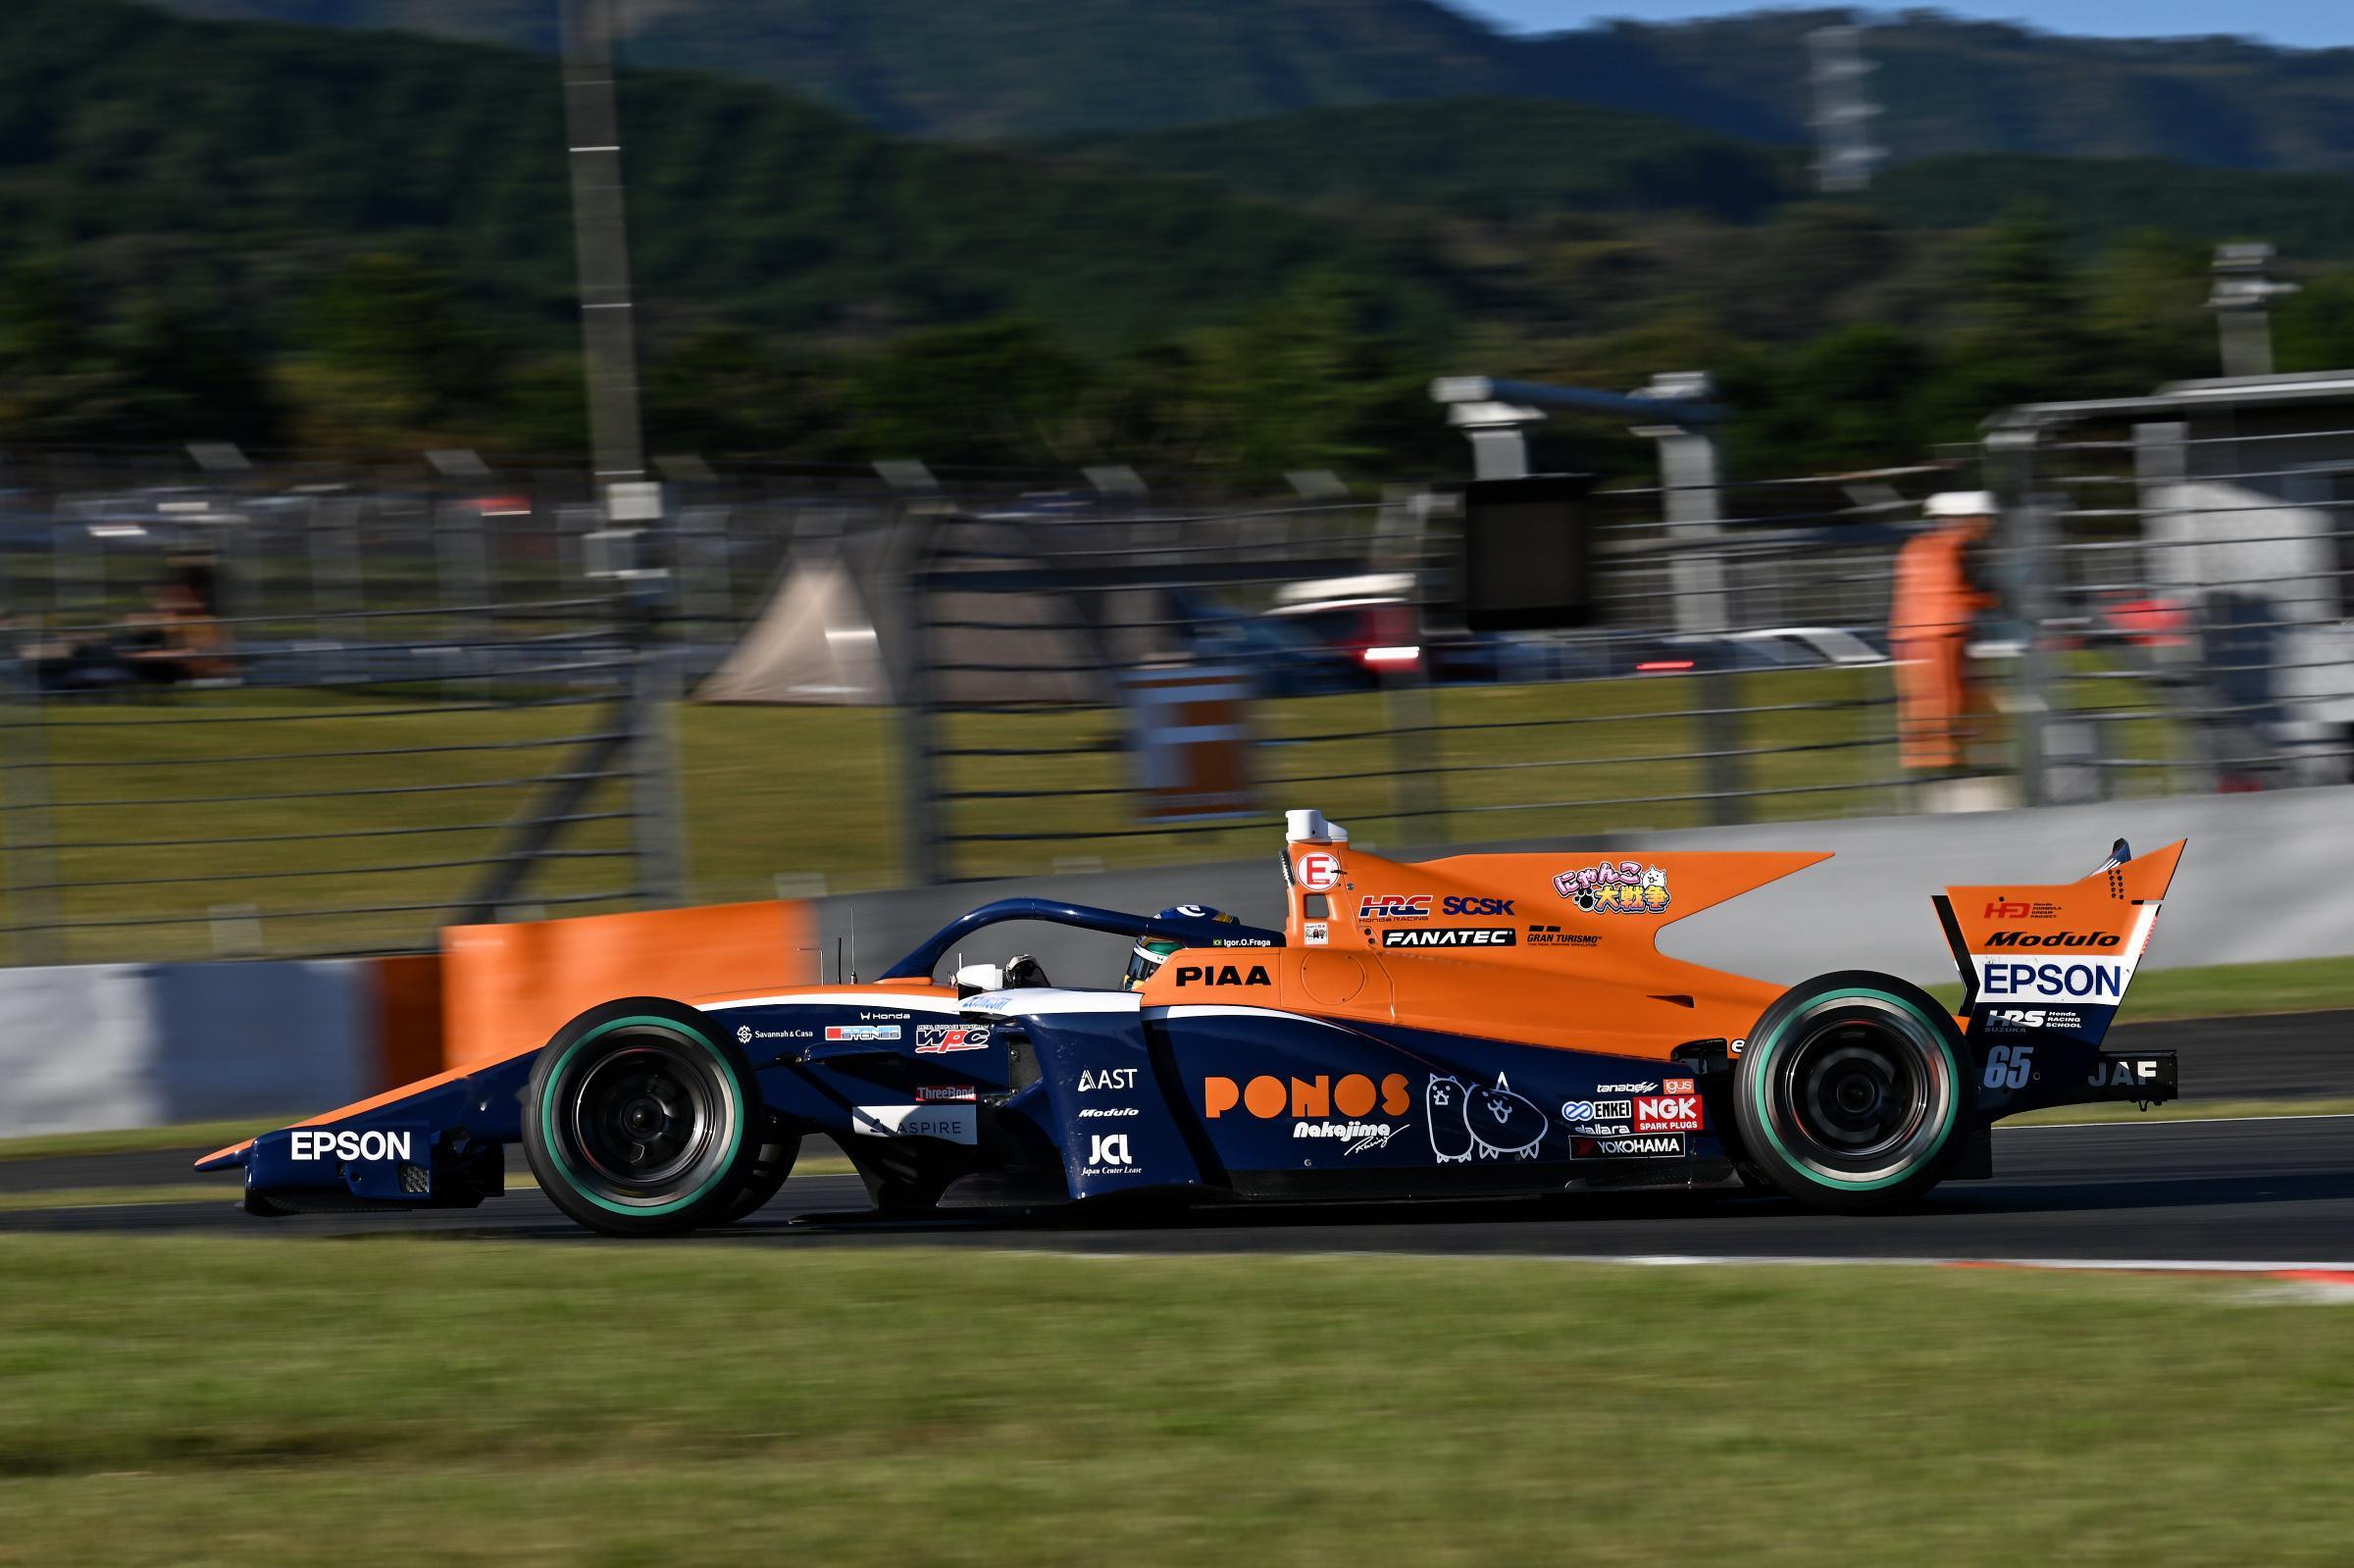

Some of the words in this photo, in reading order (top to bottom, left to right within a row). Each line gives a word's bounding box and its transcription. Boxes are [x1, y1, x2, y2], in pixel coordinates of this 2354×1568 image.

[1306, 857, 1330, 885] E
[1553, 862, 1642, 895] にゃんこ
[1358, 894, 1433, 918] HRC
[1442, 896, 1515, 916] SCSK
[1593, 885, 1670, 913] 大戦争
[1223, 938, 1271, 948] Igor.O.Fraga
[1385, 931, 1509, 945] FANATEC
[1527, 934, 1554, 942] GRAN
[1557, 935, 1599, 943] TURISMO
[1984, 932, 2121, 946] Modulo
[1176, 966, 1271, 986] PIAA
[1984, 964, 2121, 996] EPSON
[1986, 1010, 2046, 1028] HRS
[1983, 1045, 2034, 1089] 65
[2087, 1061, 2157, 1087] JAF
[917, 1087, 975, 1099] ThreeBond
[1204, 1074, 1410, 1119] PONOS
[1079, 1108, 1139, 1118] Modulo
[1595, 1102, 1630, 1117] ENKEI
[1639, 1097, 1697, 1120] NGK
[896, 1122, 961, 1134] ASPIRE
[1575, 1124, 1630, 1136] dallara
[290, 1131, 411, 1161] EPSON
[1089, 1134, 1133, 1165] JCL
[1597, 1138, 1680, 1154] YOKOHAMA
[1081, 1167, 1100, 1177] Japan
[1101, 1166, 1123, 1175] Center
